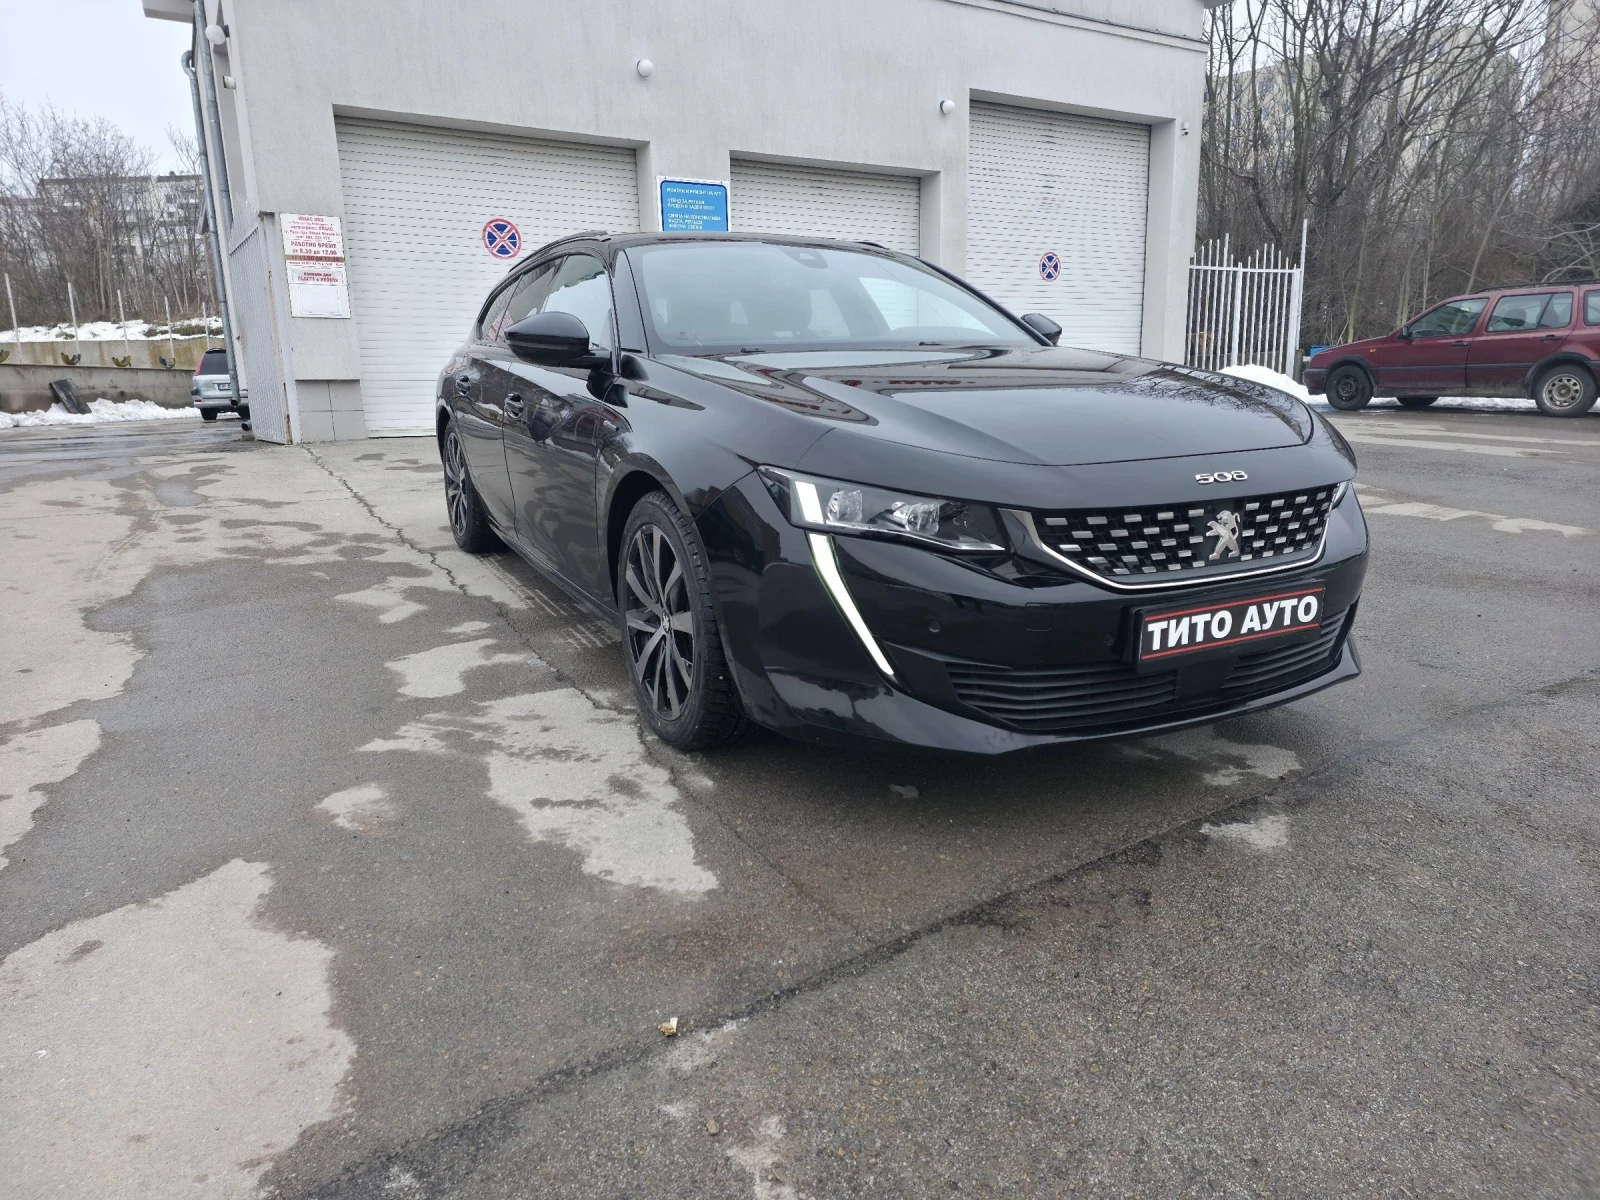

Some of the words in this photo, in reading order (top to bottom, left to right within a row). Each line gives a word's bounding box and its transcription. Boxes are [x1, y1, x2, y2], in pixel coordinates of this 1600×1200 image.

[1195, 470, 1248, 484] 508
[1147, 610, 1233, 651] ТИТО
[1240, 595, 1318, 634] АУТО
